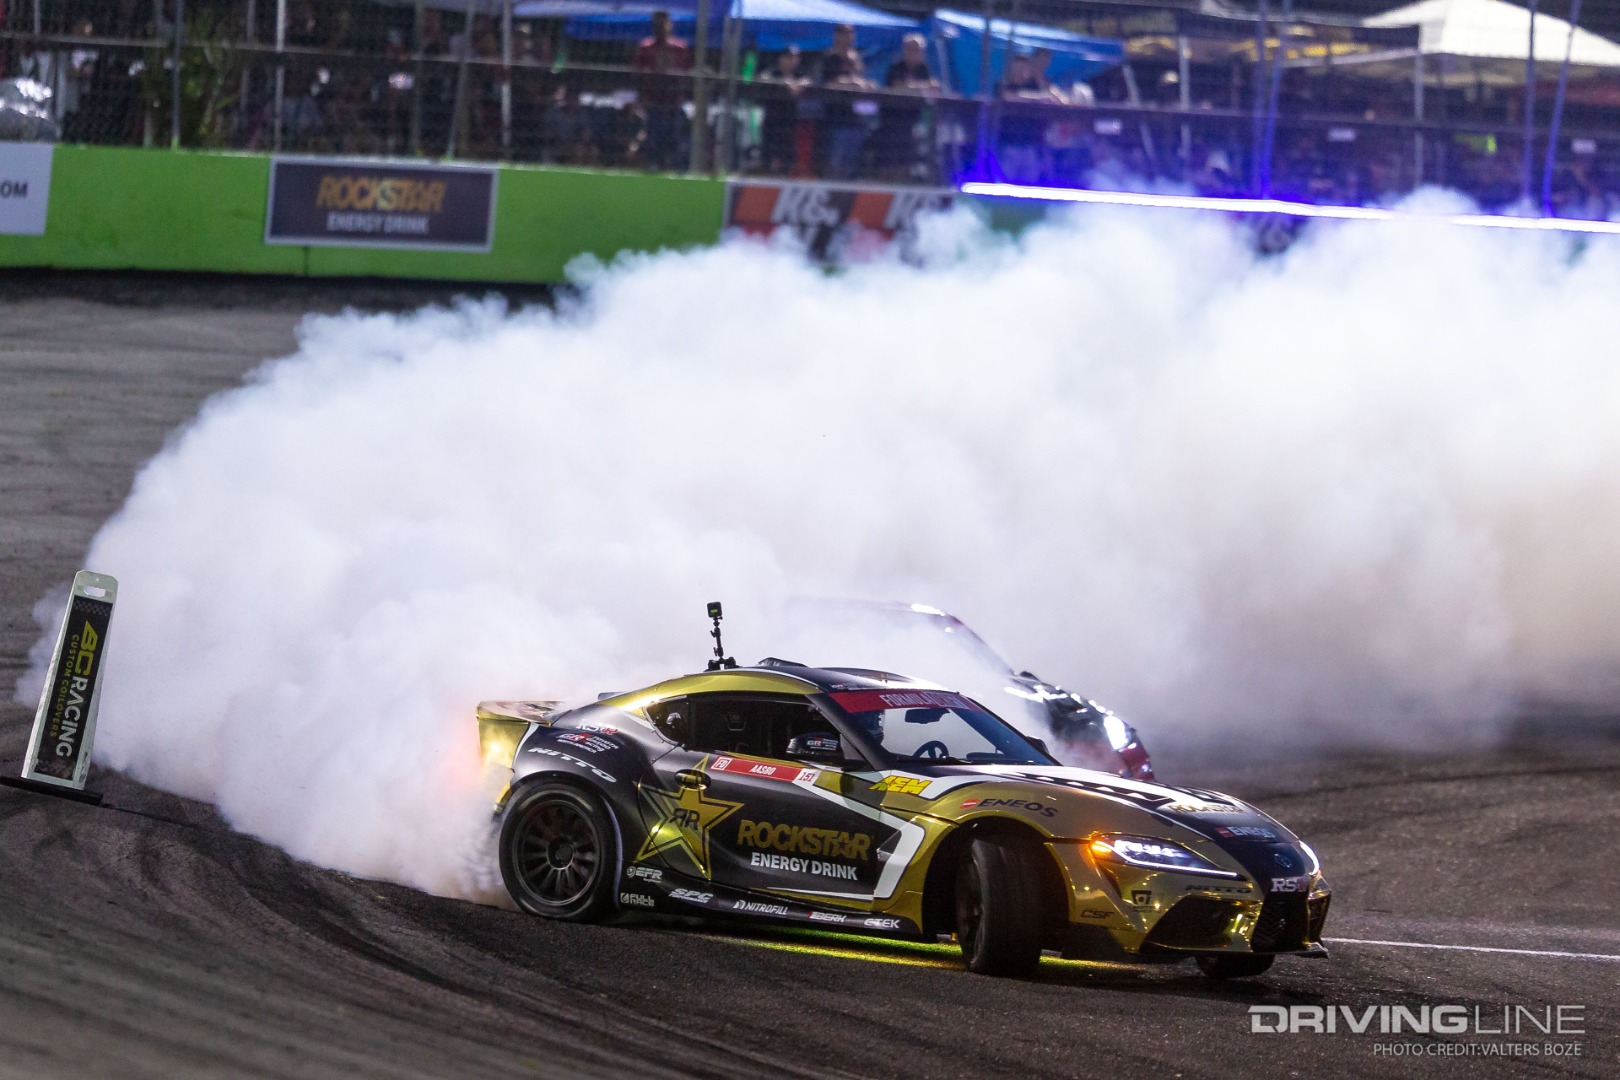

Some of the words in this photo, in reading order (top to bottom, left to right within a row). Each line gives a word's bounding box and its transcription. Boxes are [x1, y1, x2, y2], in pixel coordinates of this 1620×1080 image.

[317, 175, 446, 214] ROCKSTAR
[327, 211, 382, 232] ENERGY
[383, 215, 429, 234] DRINK
[64, 634, 80, 679] CUSTOM
[75, 620, 99, 676] BC
[50, 679, 70, 737] COILOVERS
[55, 676, 89, 757] RACING
[528, 747, 617, 782] NITTO
[749, 764, 777, 776] AASBO
[869, 775, 933, 796] AEM
[977, 798, 1060, 818] ENEOS
[736, 819, 871, 861] ROCKSTAR
[635, 867, 663, 880] EFR
[750, 852, 810, 872] ENERGY
[811, 860, 858, 881] DRINK
[745, 902, 789, 916] NITROFILL
[1081, 910, 1114, 920] CSF
